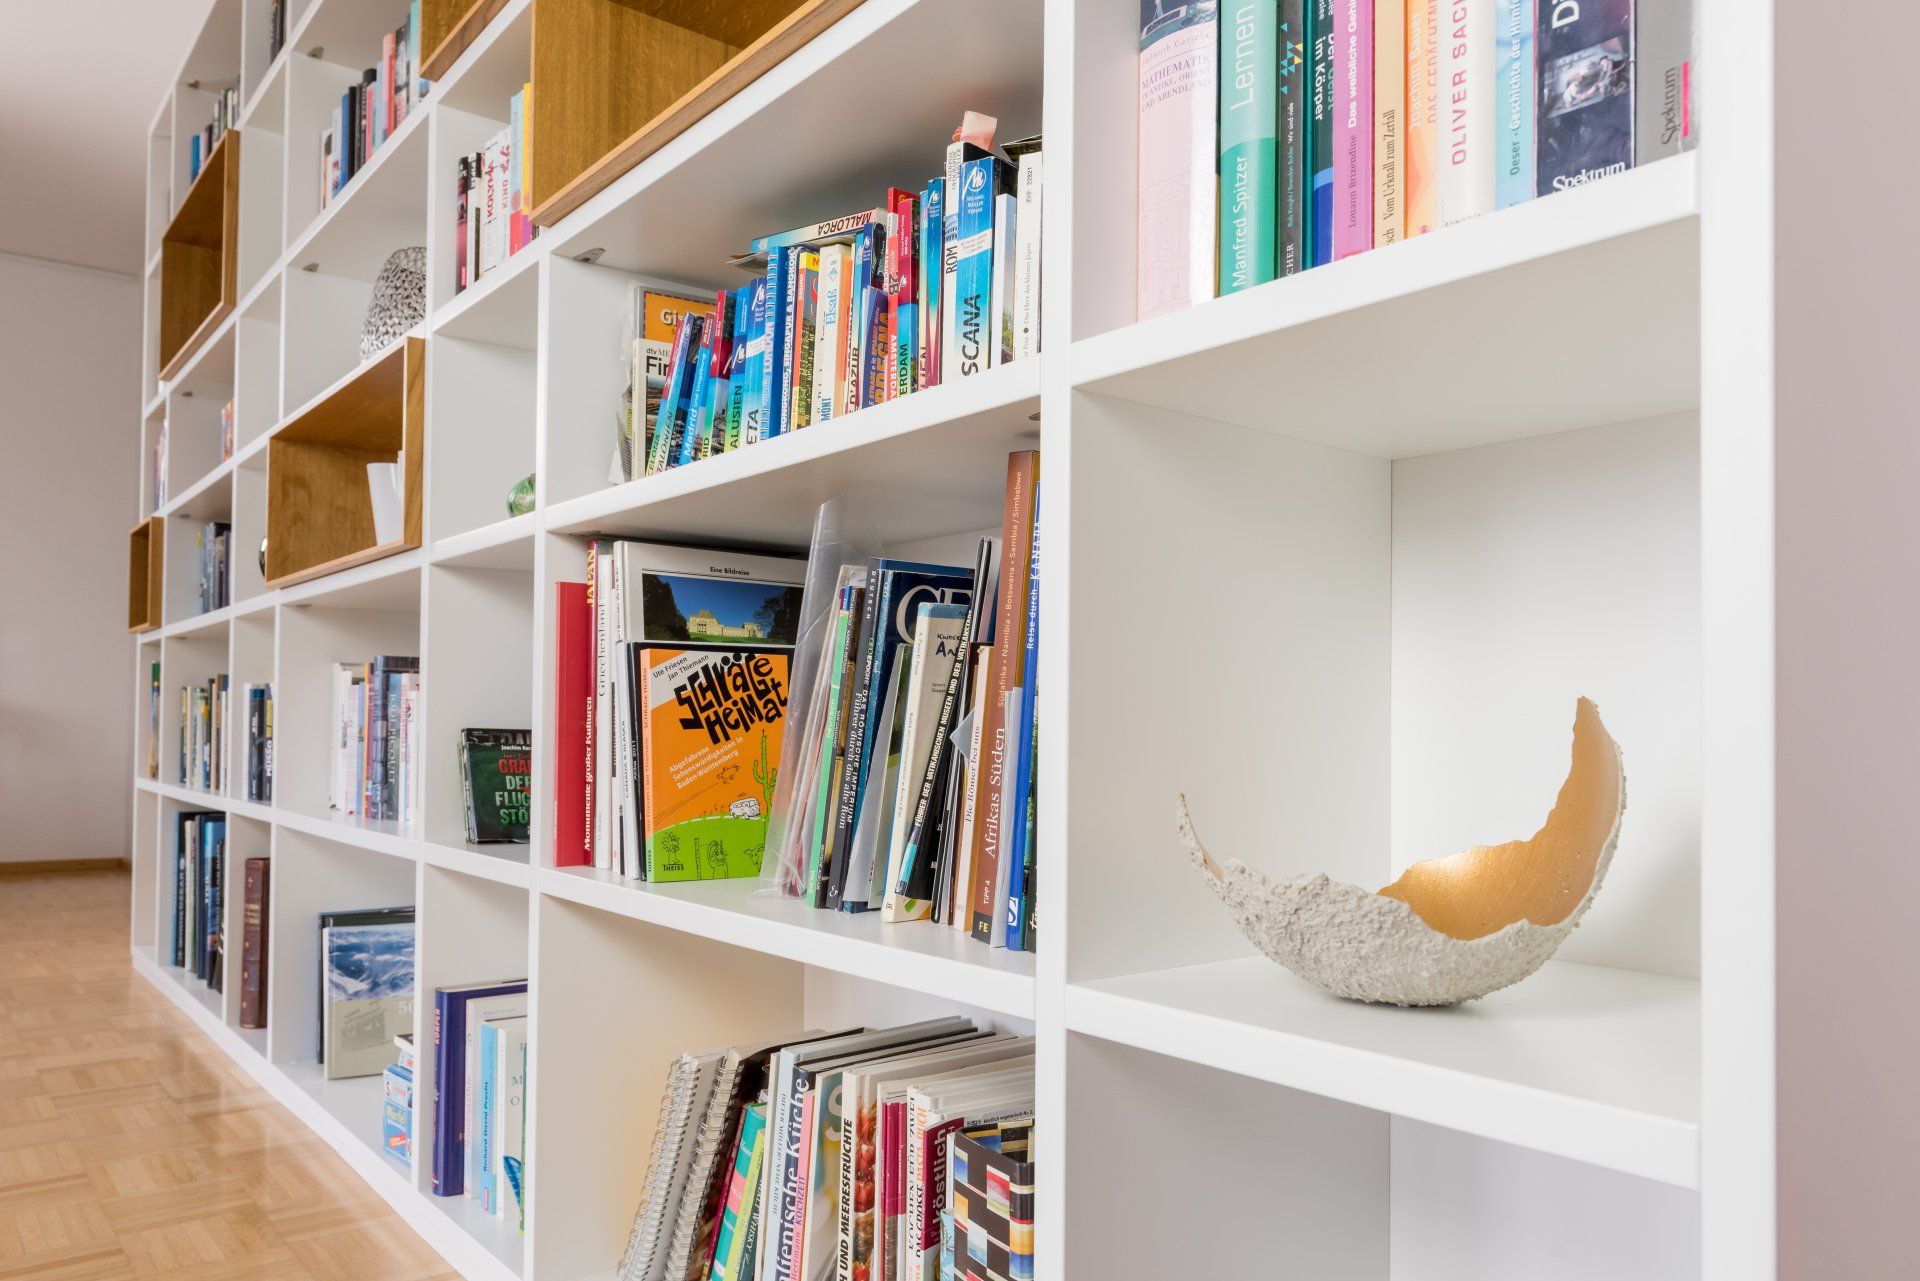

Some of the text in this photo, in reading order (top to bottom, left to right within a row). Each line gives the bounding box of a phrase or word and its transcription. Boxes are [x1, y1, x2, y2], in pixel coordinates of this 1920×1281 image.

[1142, 54, 1212, 89] MATHEMATIK
[1229, 4, 1256, 110] Lernen
[1313, 36, 1327, 121] im Körper
[1347, 34, 1358, 128] Das weibliche
[1409, 61, 1422, 130] Joachim
[1508, 38, 1521, 132] Geschichte der
[1452, 69, 1467, 166] OLIVER
[1660, 66, 1681, 146] Spektrum
[1382, 109, 1396, 221] Vom Urknall zum Zerfall
[1509, 140, 1521, 176] Oeser
[1552, 161, 1626, 193] Spektrum
[1348, 134, 1357, 229] Louann Brizendine
[817, 209, 873, 237] MALLORCA
[1231, 155, 1249, 287] Manfred Spitzer
[944, 245, 958, 275] ROM
[825, 288, 838, 326] Elsaß
[961, 293, 981, 378] SCANA
[899, 343, 908, 396] ERDAM
[730, 385, 743, 449] ALUSIEN
[746, 409, 759, 445] ETA
[821, 397, 832, 422] MONT
[684, 408, 698, 457] Madrid
[587, 549, 595, 605] JAPAN
[709, 566, 751, 576] Eine Bildreise
[866, 570, 877, 620] DEUTSCH
[1029, 589, 1039, 619] durch
[998, 567, 1016, 707] Südafrika Namibia Botswana
[1026, 619, 1036, 650] Reise
[653, 656, 688, 679] Ute Friesen
[667, 654, 710, 681] Jan Thiemann
[948, 678, 958, 696] UND
[952, 662, 962, 679] DER
[852, 692, 863, 729] Führer
[942, 695, 953, 725] MUSEEN
[668, 745, 711, 774] Abgefahrene
[672, 736, 744, 782] Sehenswürdigkeiten in
[848, 729, 858, 760] durch
[852, 711, 866, 772] RÖMISCHE
[927, 722, 945, 780] VATIKANISCHEN
[971, 748, 979, 767] bei
[584, 696, 593, 851] Monumente großer Kulturen
[676, 749, 740, 790] Baden-Württemberg
[842, 781, 850, 801] alte
[922, 782, 932, 800] DER
[967, 767, 976, 807] Römer
[846, 772, 858, 823] IMPERIUM
[914, 799, 927, 827] FÜHRER
[983, 727, 1005, 859] Afrikas Süden
[838, 802, 848, 829] Rom
[662, 864, 685, 872] THEISS
[983, 889, 991, 905] TIPP
[785, 1078, 811, 1154] Küche
[839, 1118, 853, 1272] UND MEERESFRÜCHTE
[931, 1127, 947, 1225] köstlich
[795, 1176, 806, 1226] KOCHZEIT
[748, 1205, 763, 1253] WHISKY
